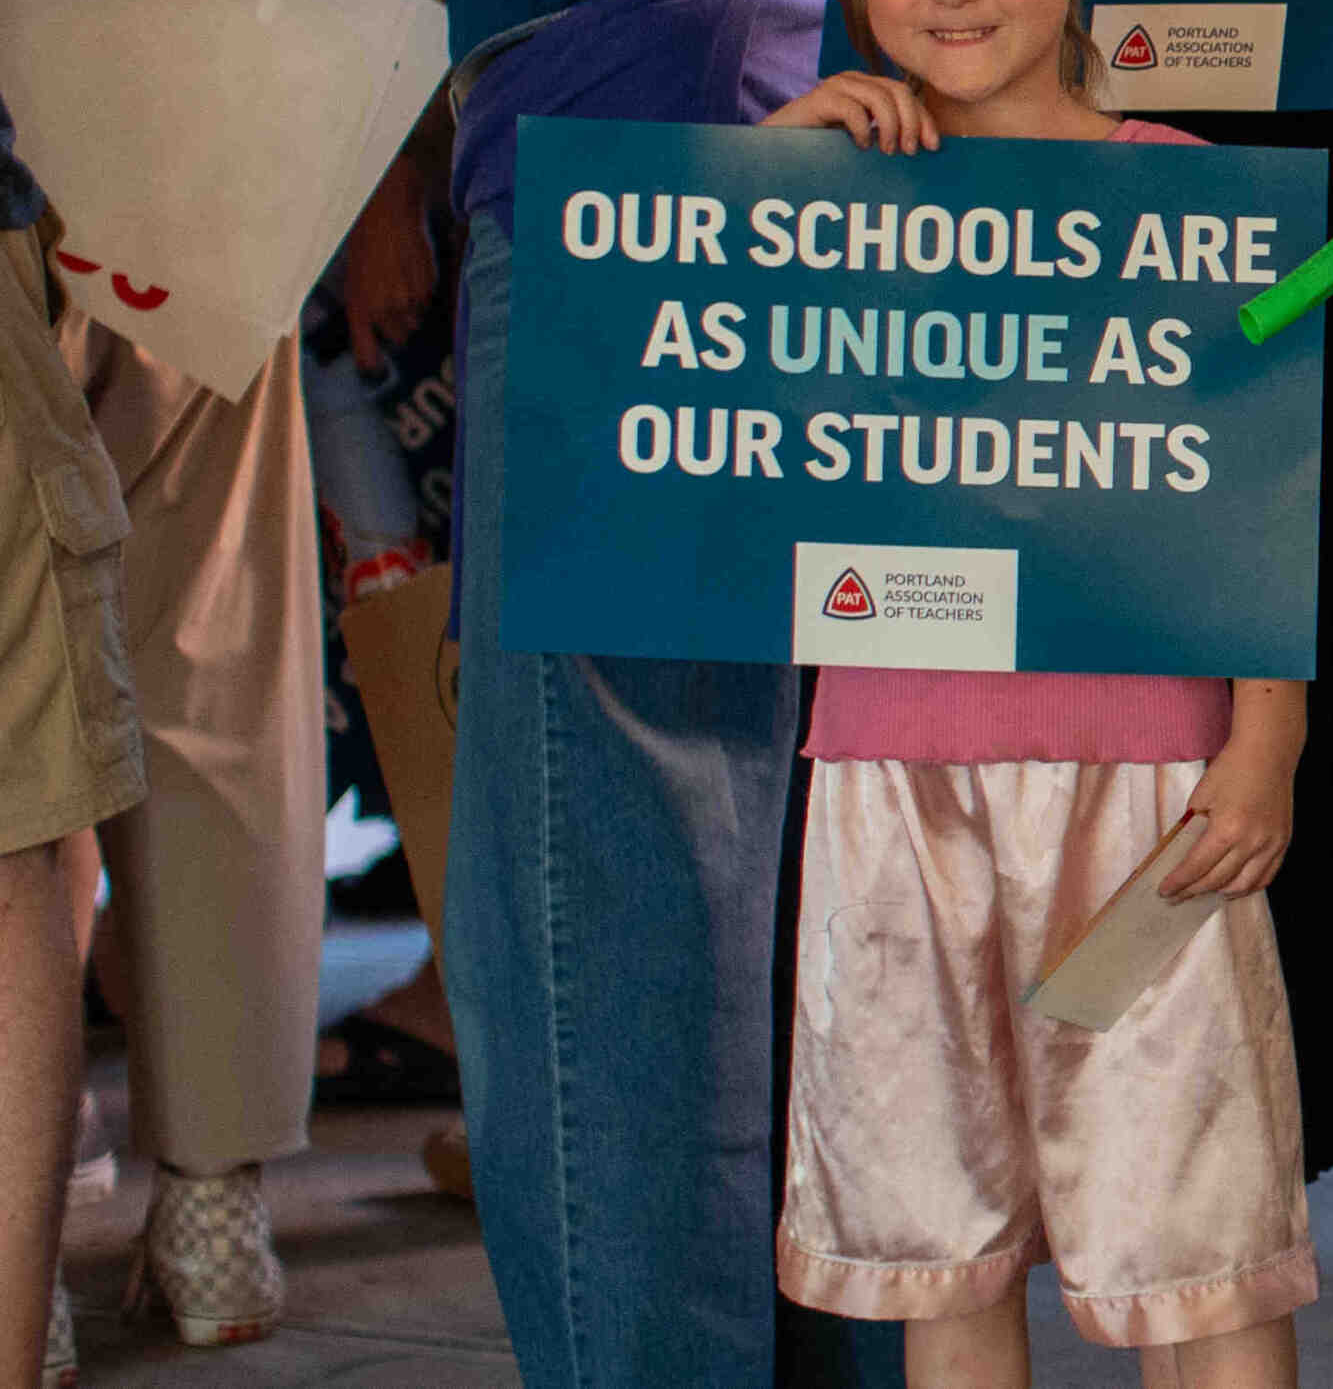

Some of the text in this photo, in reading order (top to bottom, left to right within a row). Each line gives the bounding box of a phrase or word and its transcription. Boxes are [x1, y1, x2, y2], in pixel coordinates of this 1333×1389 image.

[1167, 27, 1240, 39] PORTLAND
[1124, 46, 1147, 59] PAT
[1165, 42, 1254, 53] ASSOCIATION
[1164, 56, 1252, 68] OF TEACHERS
[562, 190, 1279, 285] OUR SCHOOLS ARE
[641, 300, 1193, 388] AS UNIQUE AS
[618, 405, 1212, 492] OUR STUDENTS
[885, 573, 966, 588] PORTLAND
[836, 593, 863, 606] PAT
[884, 590, 984, 605] ASSOCIATION
[883, 606, 984, 621] OF TEACHERS
